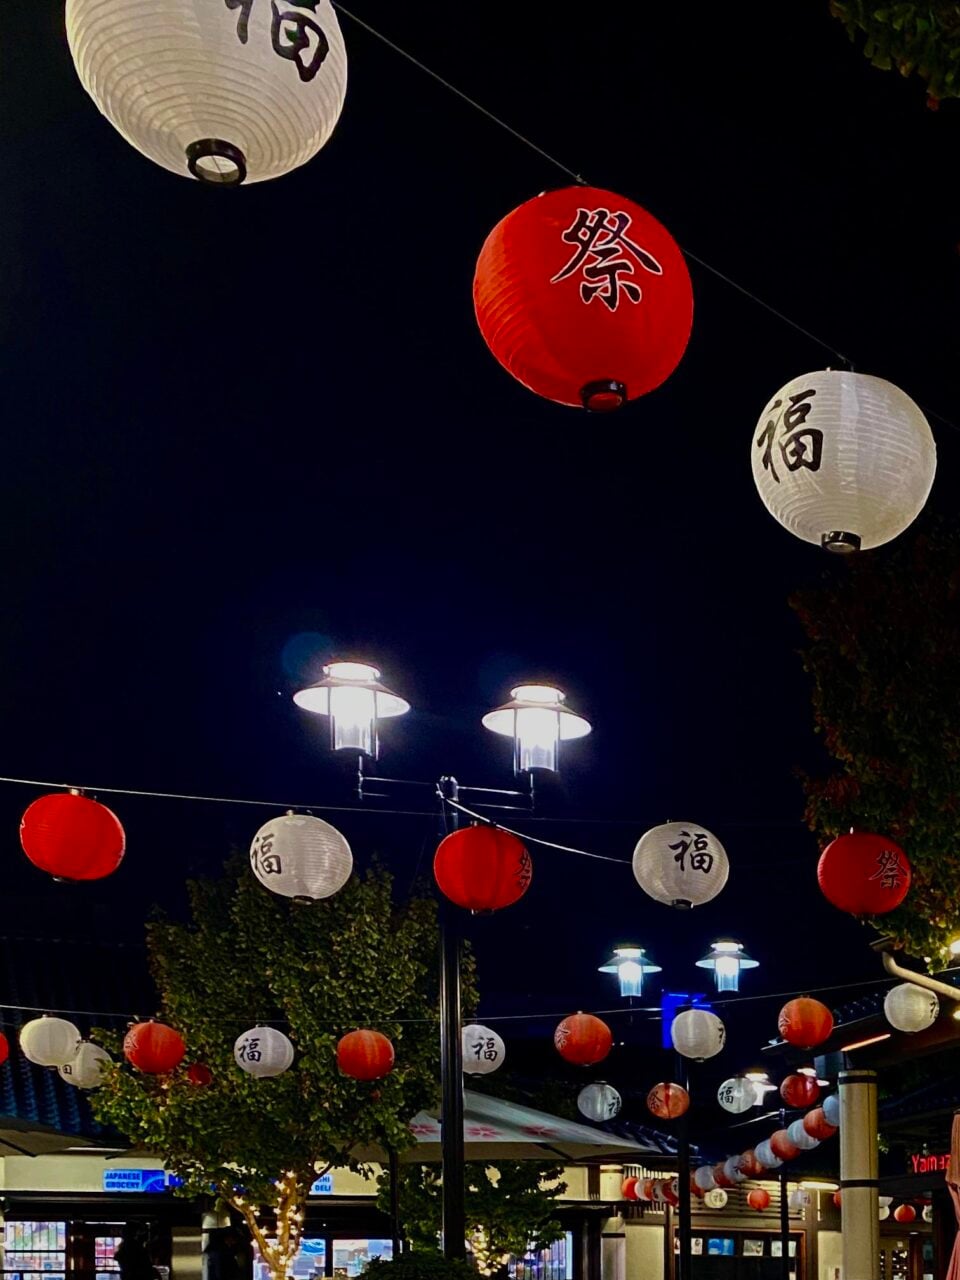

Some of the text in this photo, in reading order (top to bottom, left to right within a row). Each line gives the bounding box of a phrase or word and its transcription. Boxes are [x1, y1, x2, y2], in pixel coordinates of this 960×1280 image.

[550, 208, 663, 312] 祭
[757, 389, 824, 484] 福
[251, 833, 282, 879] 福
[668, 831, 714, 874] 福
[868, 850, 909, 889] 祭
[238, 1037, 263, 1063] 福
[471, 1036, 498, 1062] 福
[718, 1086, 735, 1105] 福
[104, 1172, 141, 1180] JAPANESE
[105, 1181, 140, 1189] GROCERY
[314, 1184, 332, 1192] DELI
